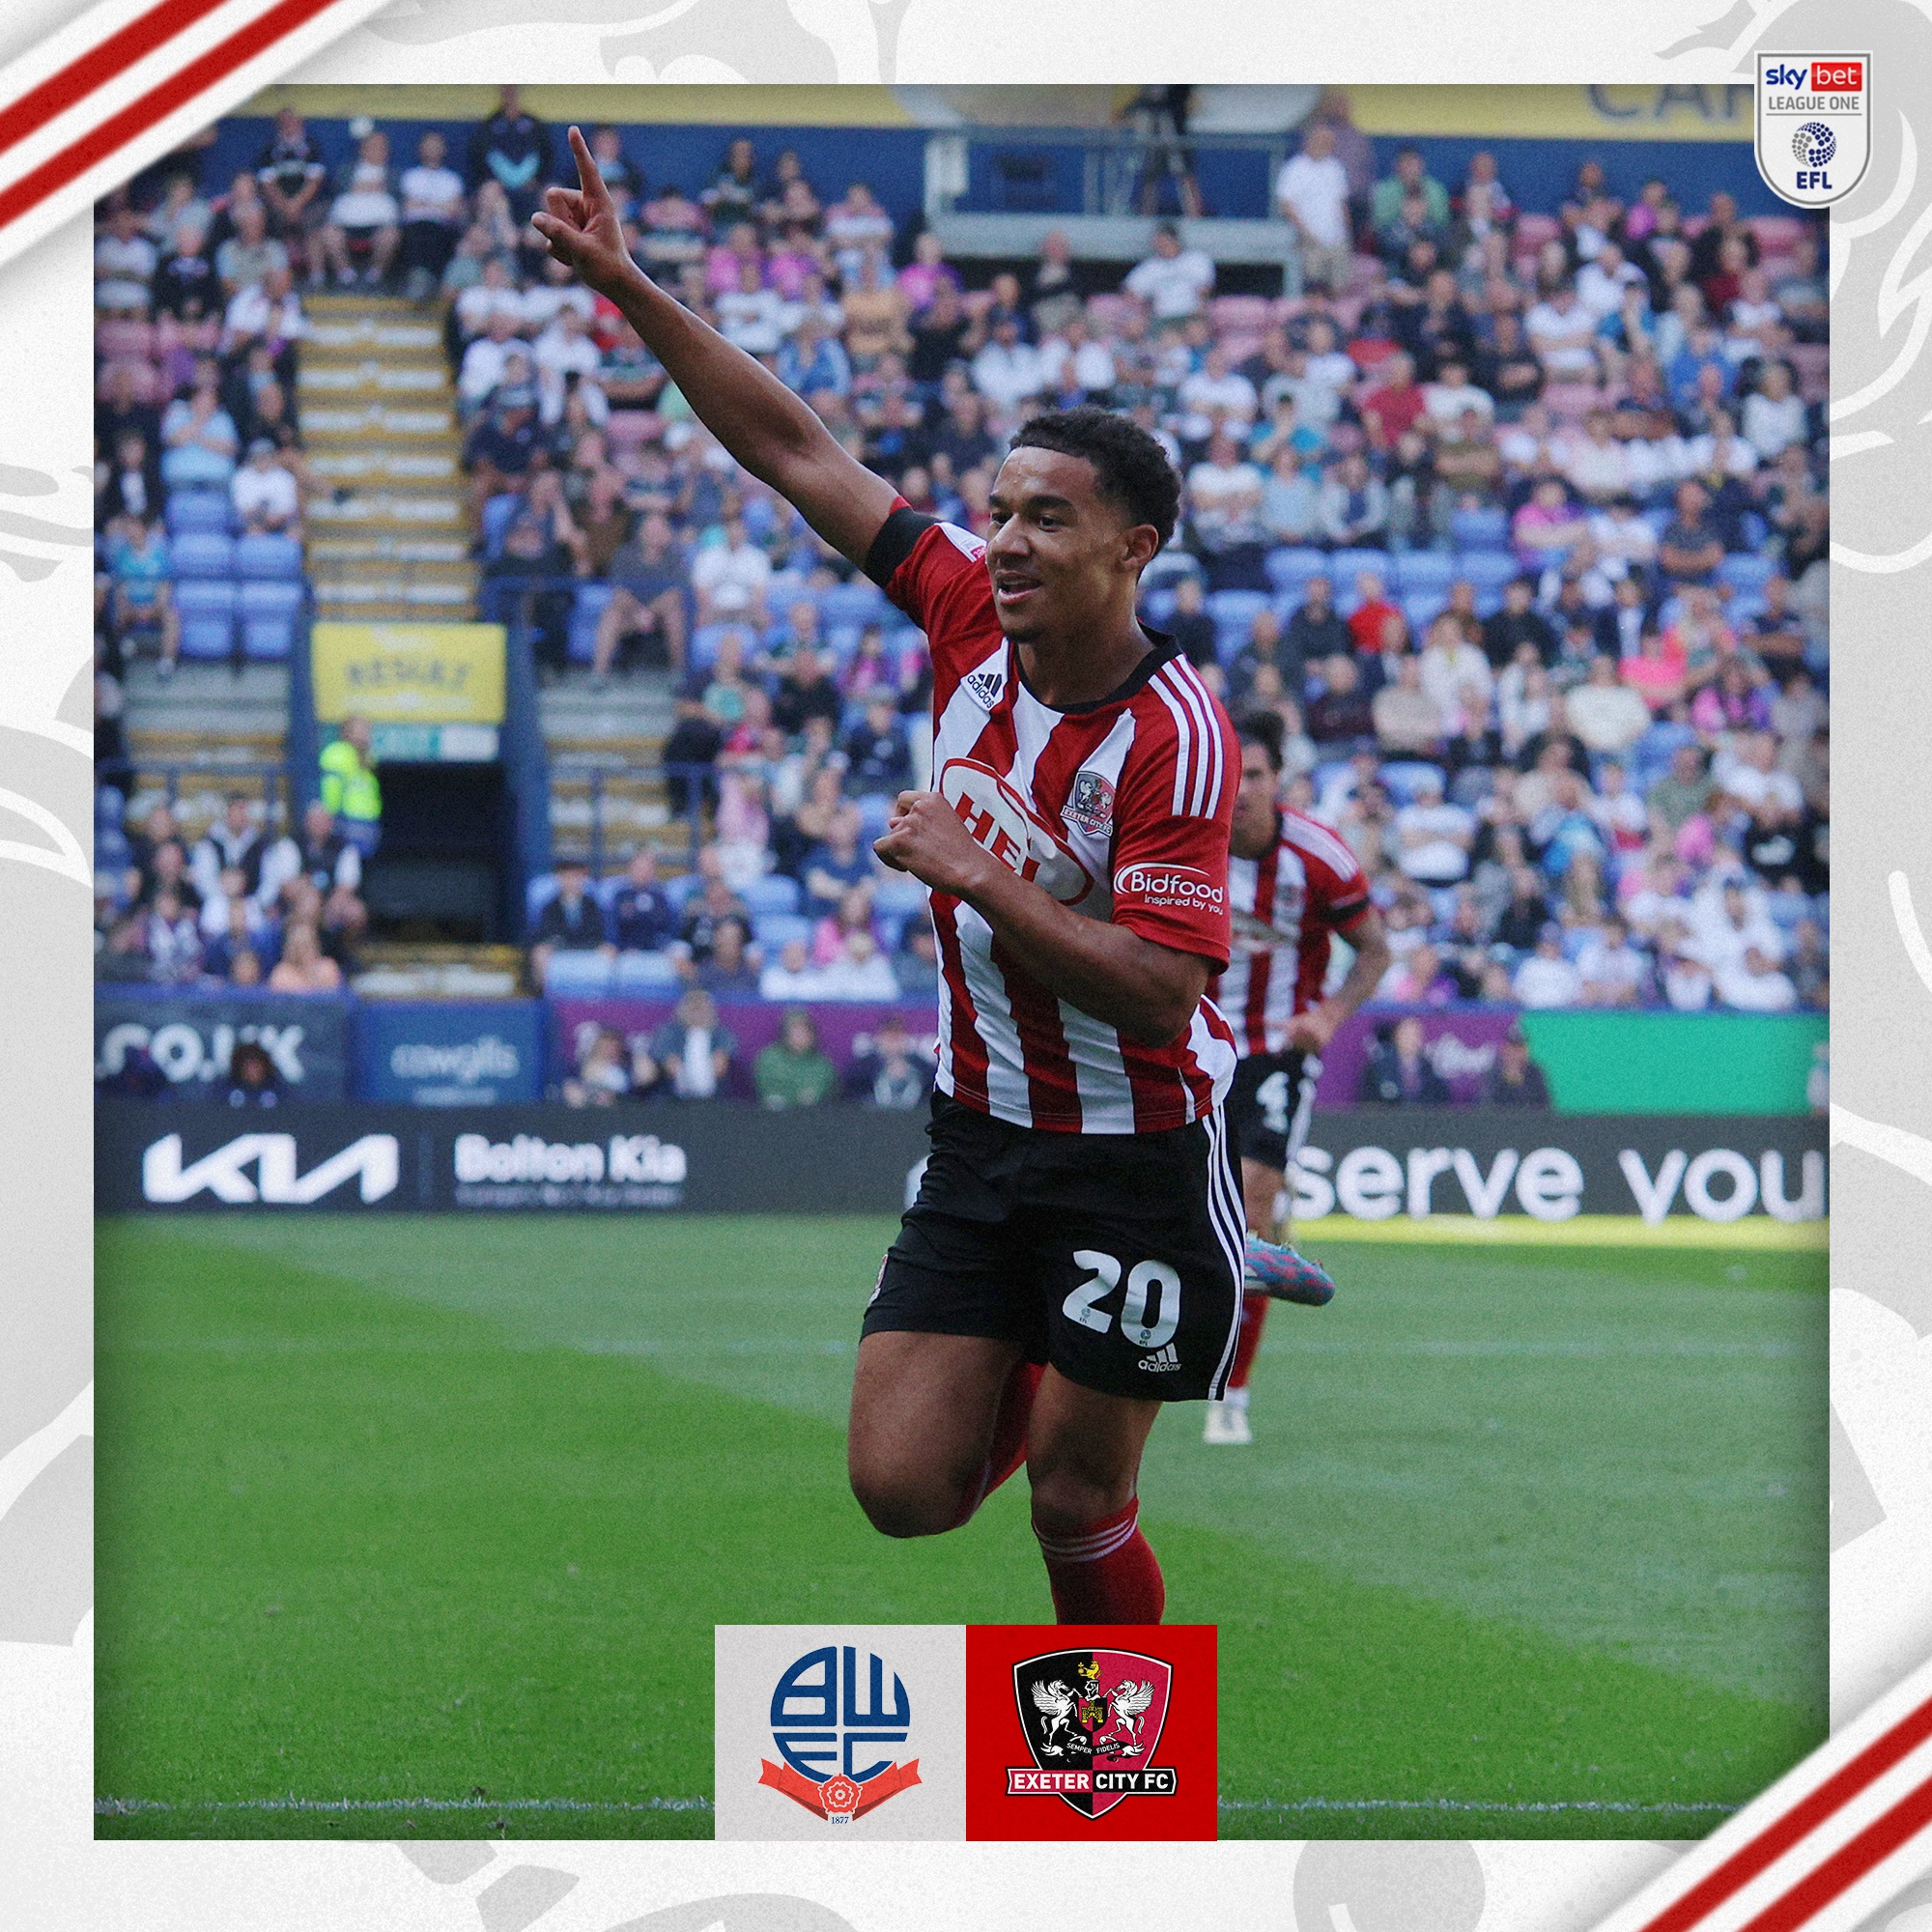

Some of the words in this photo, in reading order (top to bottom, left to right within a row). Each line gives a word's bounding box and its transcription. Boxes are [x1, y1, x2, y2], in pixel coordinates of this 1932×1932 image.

[967, 674, 995, 708] adidas
[1130, 870, 1224, 904] Bidfood
[1144, 894, 1190, 907] Inspired
[1192, 897, 1207, 911] by
[1256, 1070, 1291, 1134] 4
[142, 1132, 399, 1204] KIA
[454, 1132, 606, 1183] Bolton
[609, 1133, 688, 1184] Kia
[1290, 1146, 1584, 1222] serve
[1617, 1148, 1826, 1227] you
[1063, 1249, 1181, 1349] 20
[1138, 1359, 1182, 1373] adidas
